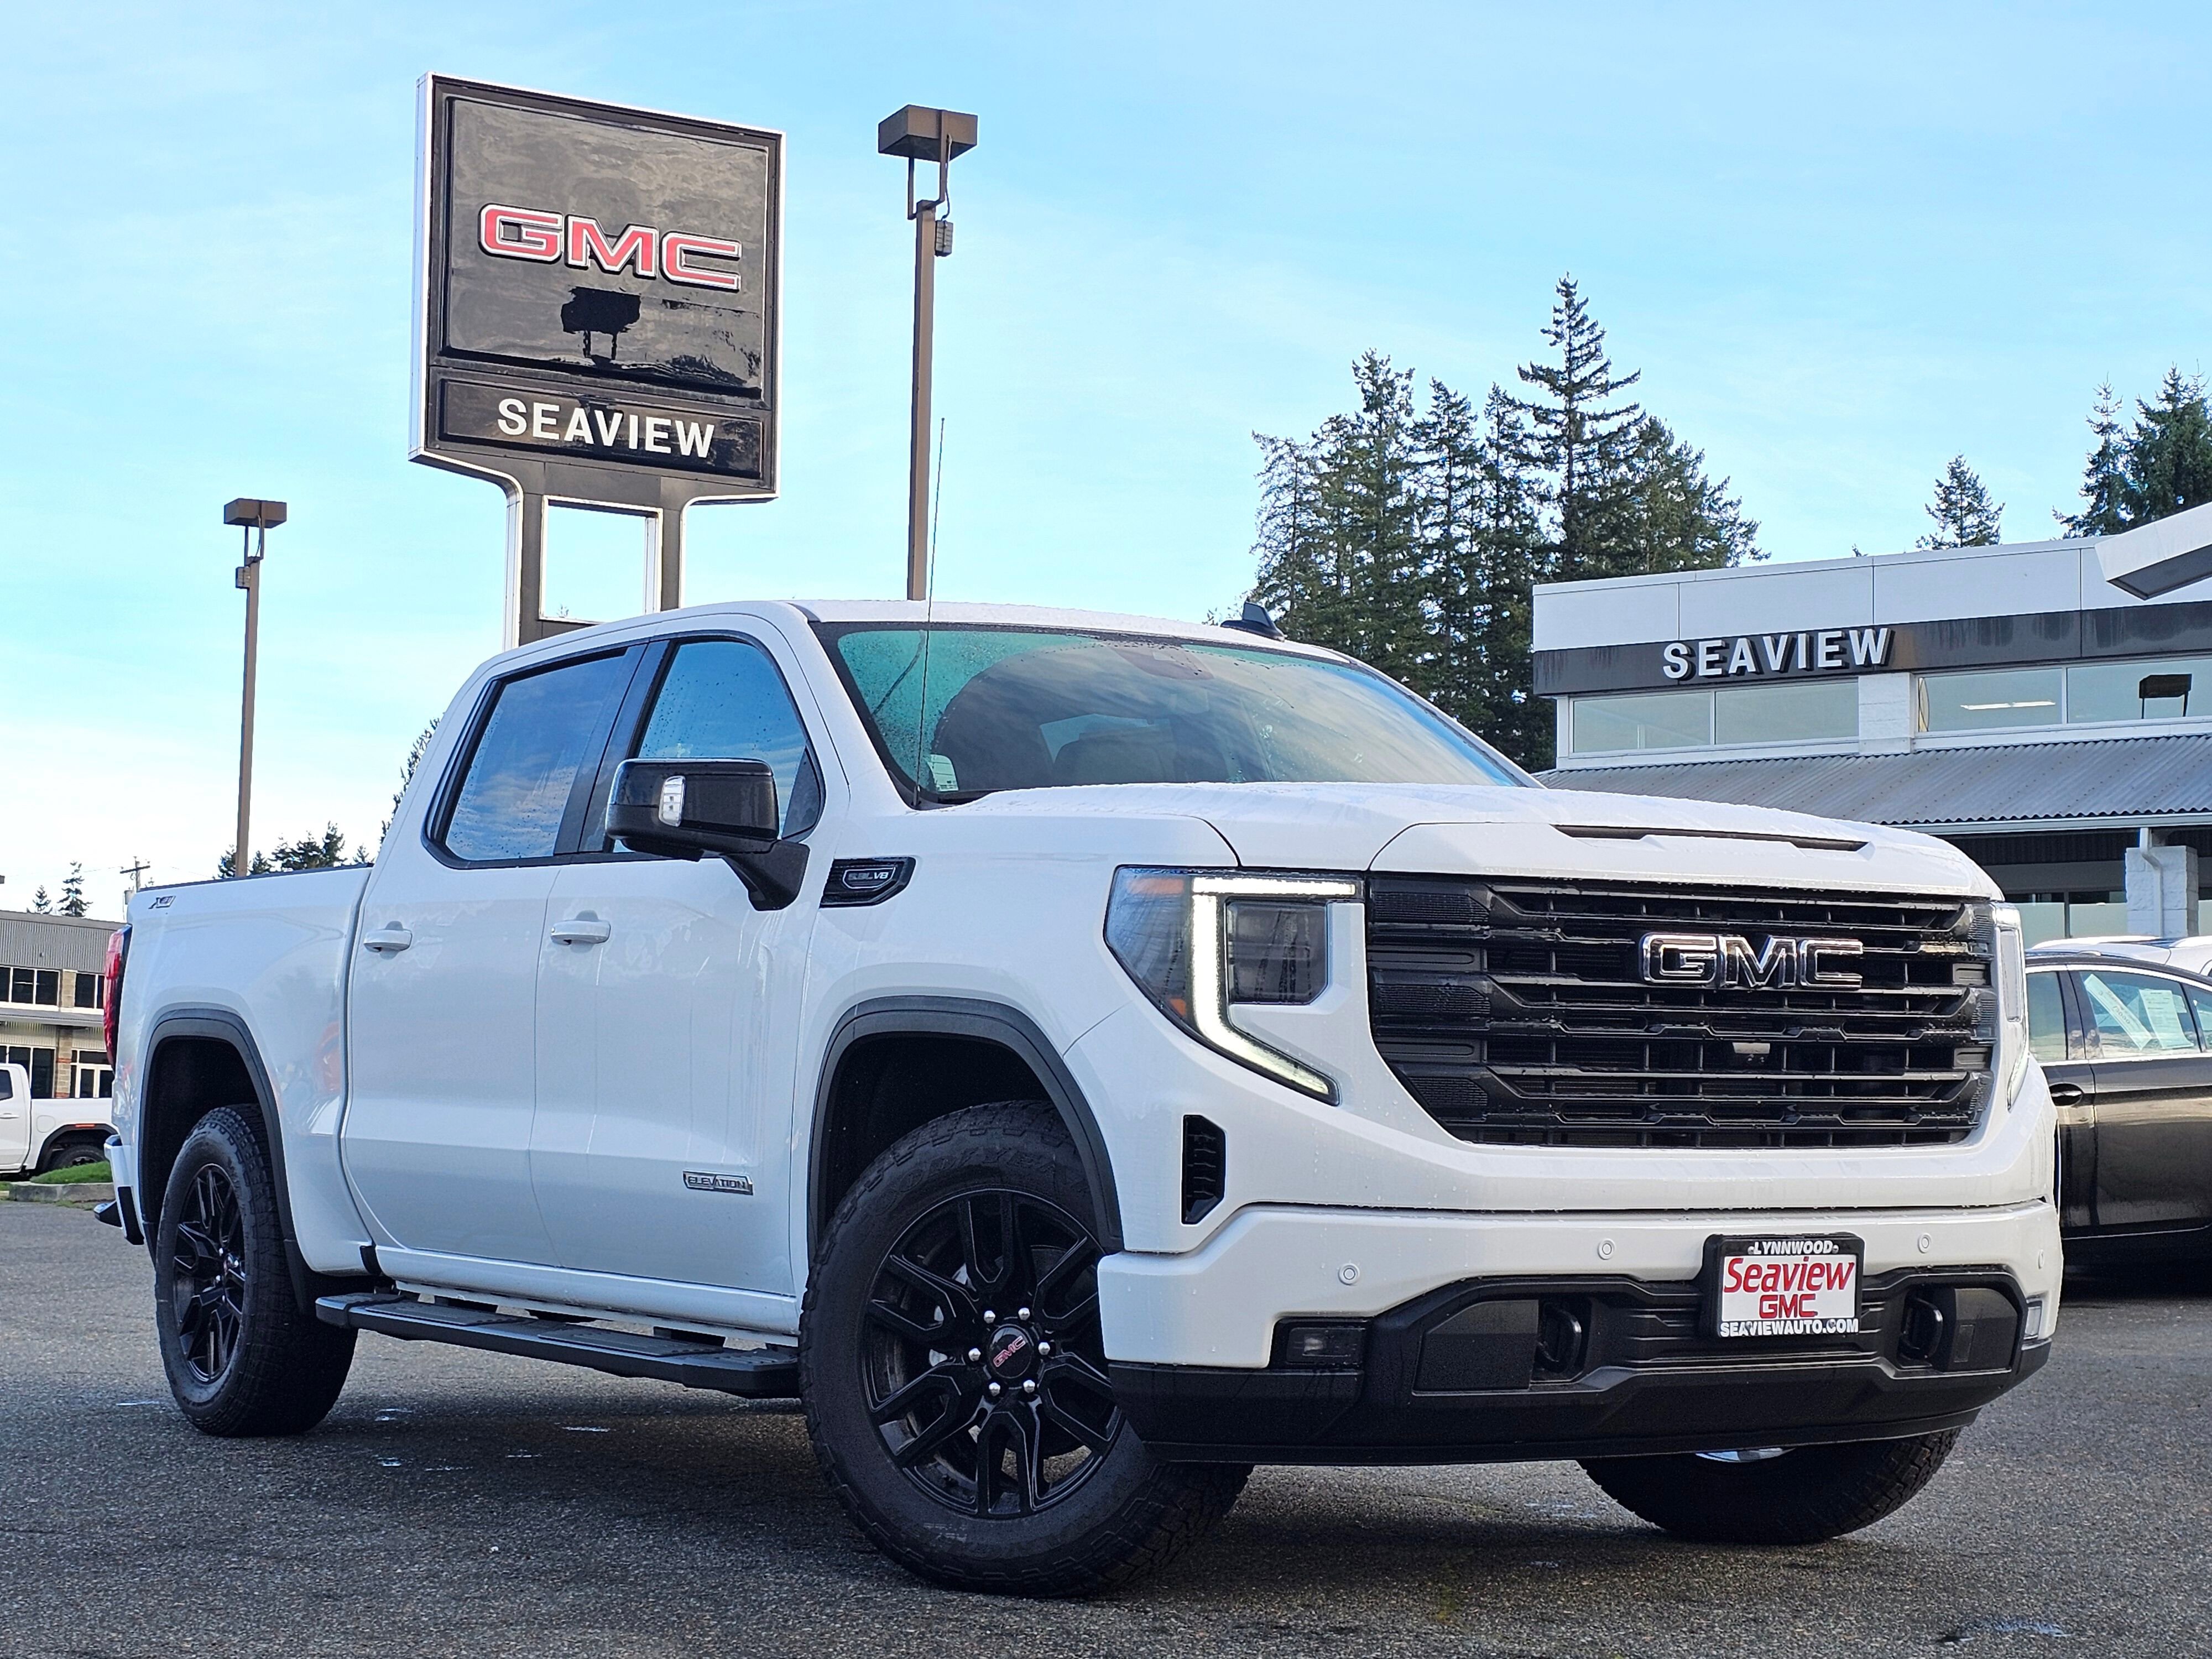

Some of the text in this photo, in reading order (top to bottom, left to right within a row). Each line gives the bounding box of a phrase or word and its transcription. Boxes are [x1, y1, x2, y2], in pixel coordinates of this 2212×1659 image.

[478, 202, 742, 291] GMC
[498, 398, 715, 458] SEAVIEW
[1662, 627, 1893, 680] SEAVIEW
[1640, 932, 1864, 989] GMC
[688, 1176, 746, 1188] ELEVATION
[1753, 1240, 1834, 1255] LYNNWOOD
[1724, 1256, 1855, 1293] Seaview
[1759, 1293, 1818, 1319] GMC
[1720, 1319, 1859, 1337] SEAVIEWAUTO.COM
[992, 1335, 1026, 1368] GMC
